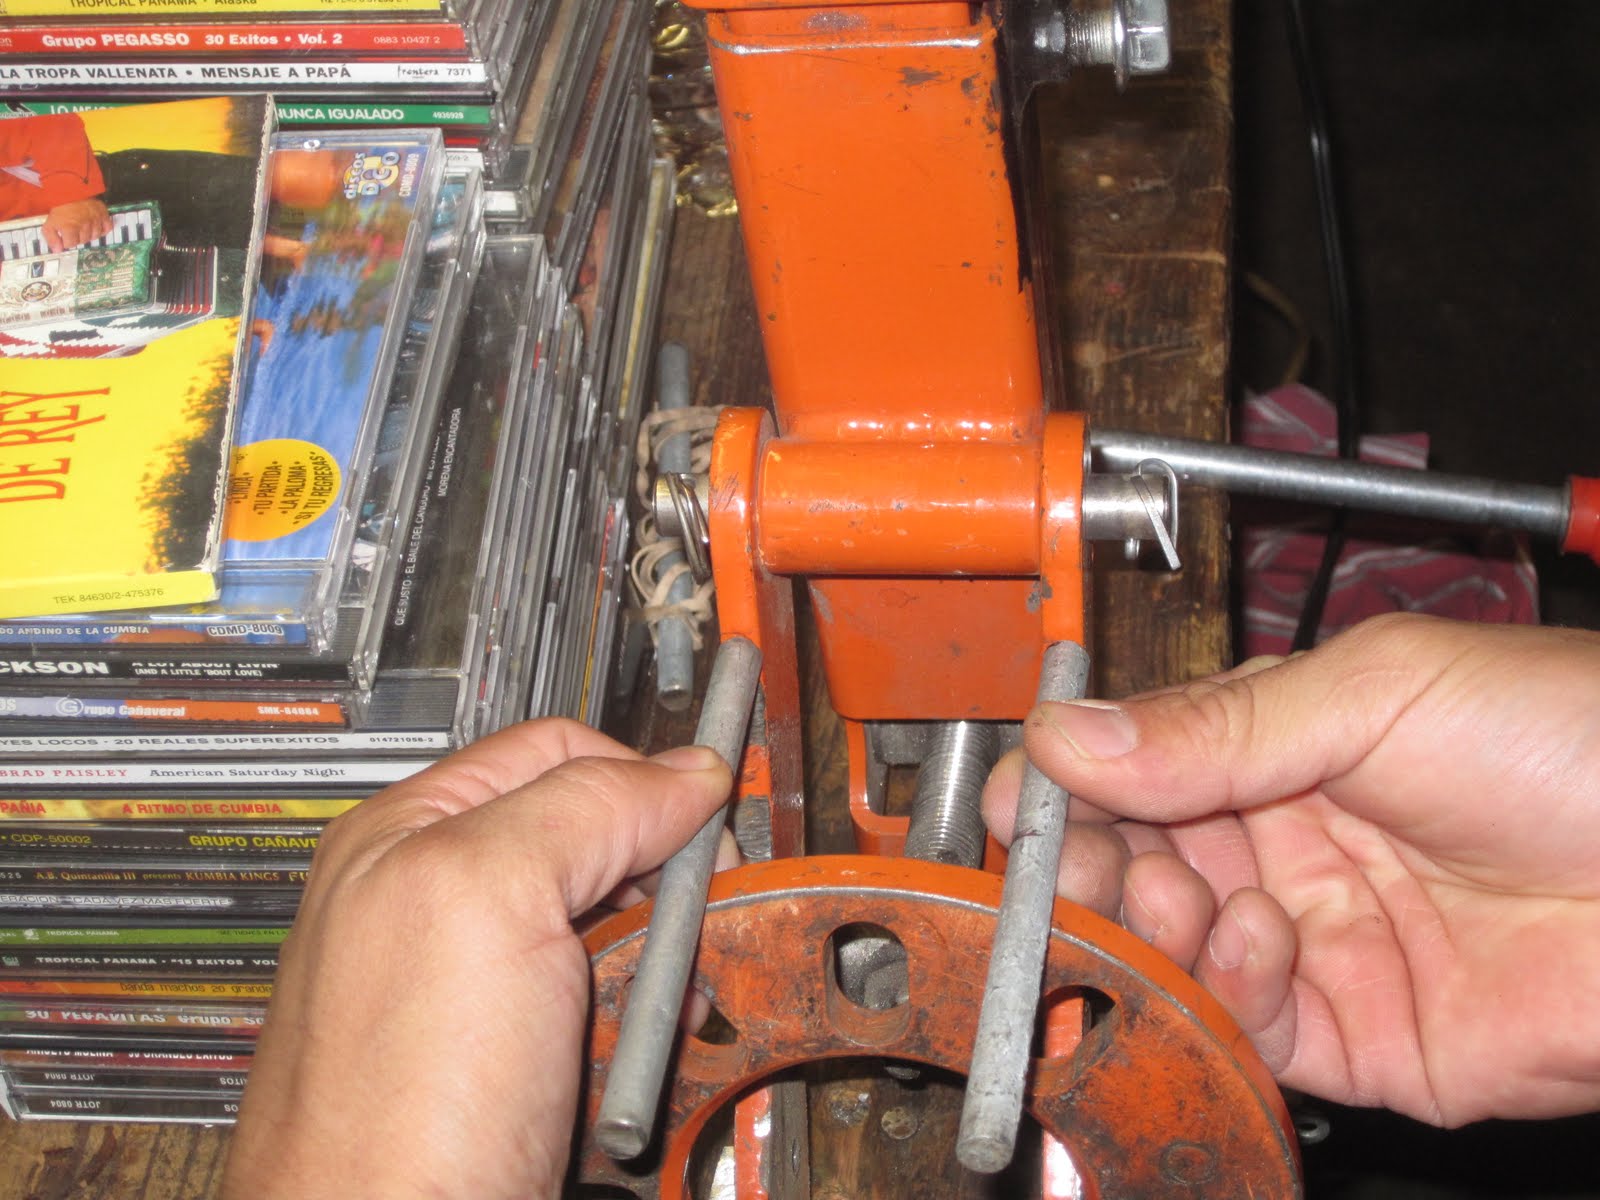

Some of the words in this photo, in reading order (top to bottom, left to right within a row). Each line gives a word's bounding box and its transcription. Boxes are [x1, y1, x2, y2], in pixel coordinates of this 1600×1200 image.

[42, 34, 97, 49] Grupo
[101, 33, 190, 47] PEGASSO
[204, 34, 224, 45] 30
[229, 33, 279, 45] Exitos
[298, 33, 327, 45] Vol.
[332, 33, 343, 44] 2
[373, 36, 398, 44] 0883
[402, 36, 430, 44] 10427
[0, 68, 20, 79] LA
[25, 67, 80, 79] TROPA
[85, 67, 178, 79] VALLENATA
[201, 67, 282, 79] MENSAJE
[287, 66, 300, 78] A
[306, 63, 352, 78] PAPÁ
[447, 67, 472, 76] 7371
[277, 107, 325, 120] NUNCA
[328, 108, 405, 120] IGUALADO
[344, 152, 367, 199] discos
[0, 386, 111, 447] REY
[443, 407, 462, 464] ENCANTADORA
[0, 457, 71, 503] DE
[256, 464, 282, 498] PARTIDA
[283, 464, 307, 498] PALOMA
[309, 455, 334, 497] REGRESAS
[437, 464, 452, 497] MORENA
[253, 500, 273, 512] TU
[278, 499, 300, 510] LA
[303, 498, 327, 510] TU
[412, 524, 424, 540] DEL
[407, 541, 420, 562] BAILE
[404, 563, 416, 574] EL
[53, 595, 76, 604] TEK
[398, 579, 413, 606] SUSTO
[394, 607, 407, 626] QUE
[18, 627, 63, 635] ANDINO
[66, 627, 81, 635] DE
[86, 627, 100, 635] LA
[103, 625, 150, 635] CUMBIA
[207, 624, 284, 637] CDMD-8009
[0, 661, 110, 675] CKSON
[119, 704, 186, 717] Cañaveral
[0, 769, 45, 777] BRAD
[53, 769, 128, 777] PAISLEY
[150, 769, 224, 777] American
[229, 768, 297, 778] Saturday
[303, 768, 346, 778] Night
[0, 800, 46, 814] PAÑIA
[122, 804, 133, 814] A
[137, 803, 187, 814] RITMO
[193, 803, 214, 814] DE
[220, 803, 283, 815] CUMBIA
[10, 834, 92, 844] CDP-50002
[189, 835, 247, 847] GRUPO
[185, 872, 237, 881] KUMBIA
[239, 871, 280, 881] KINGS
[119, 982, 154, 991] banda
[160, 983, 205, 993] machos
